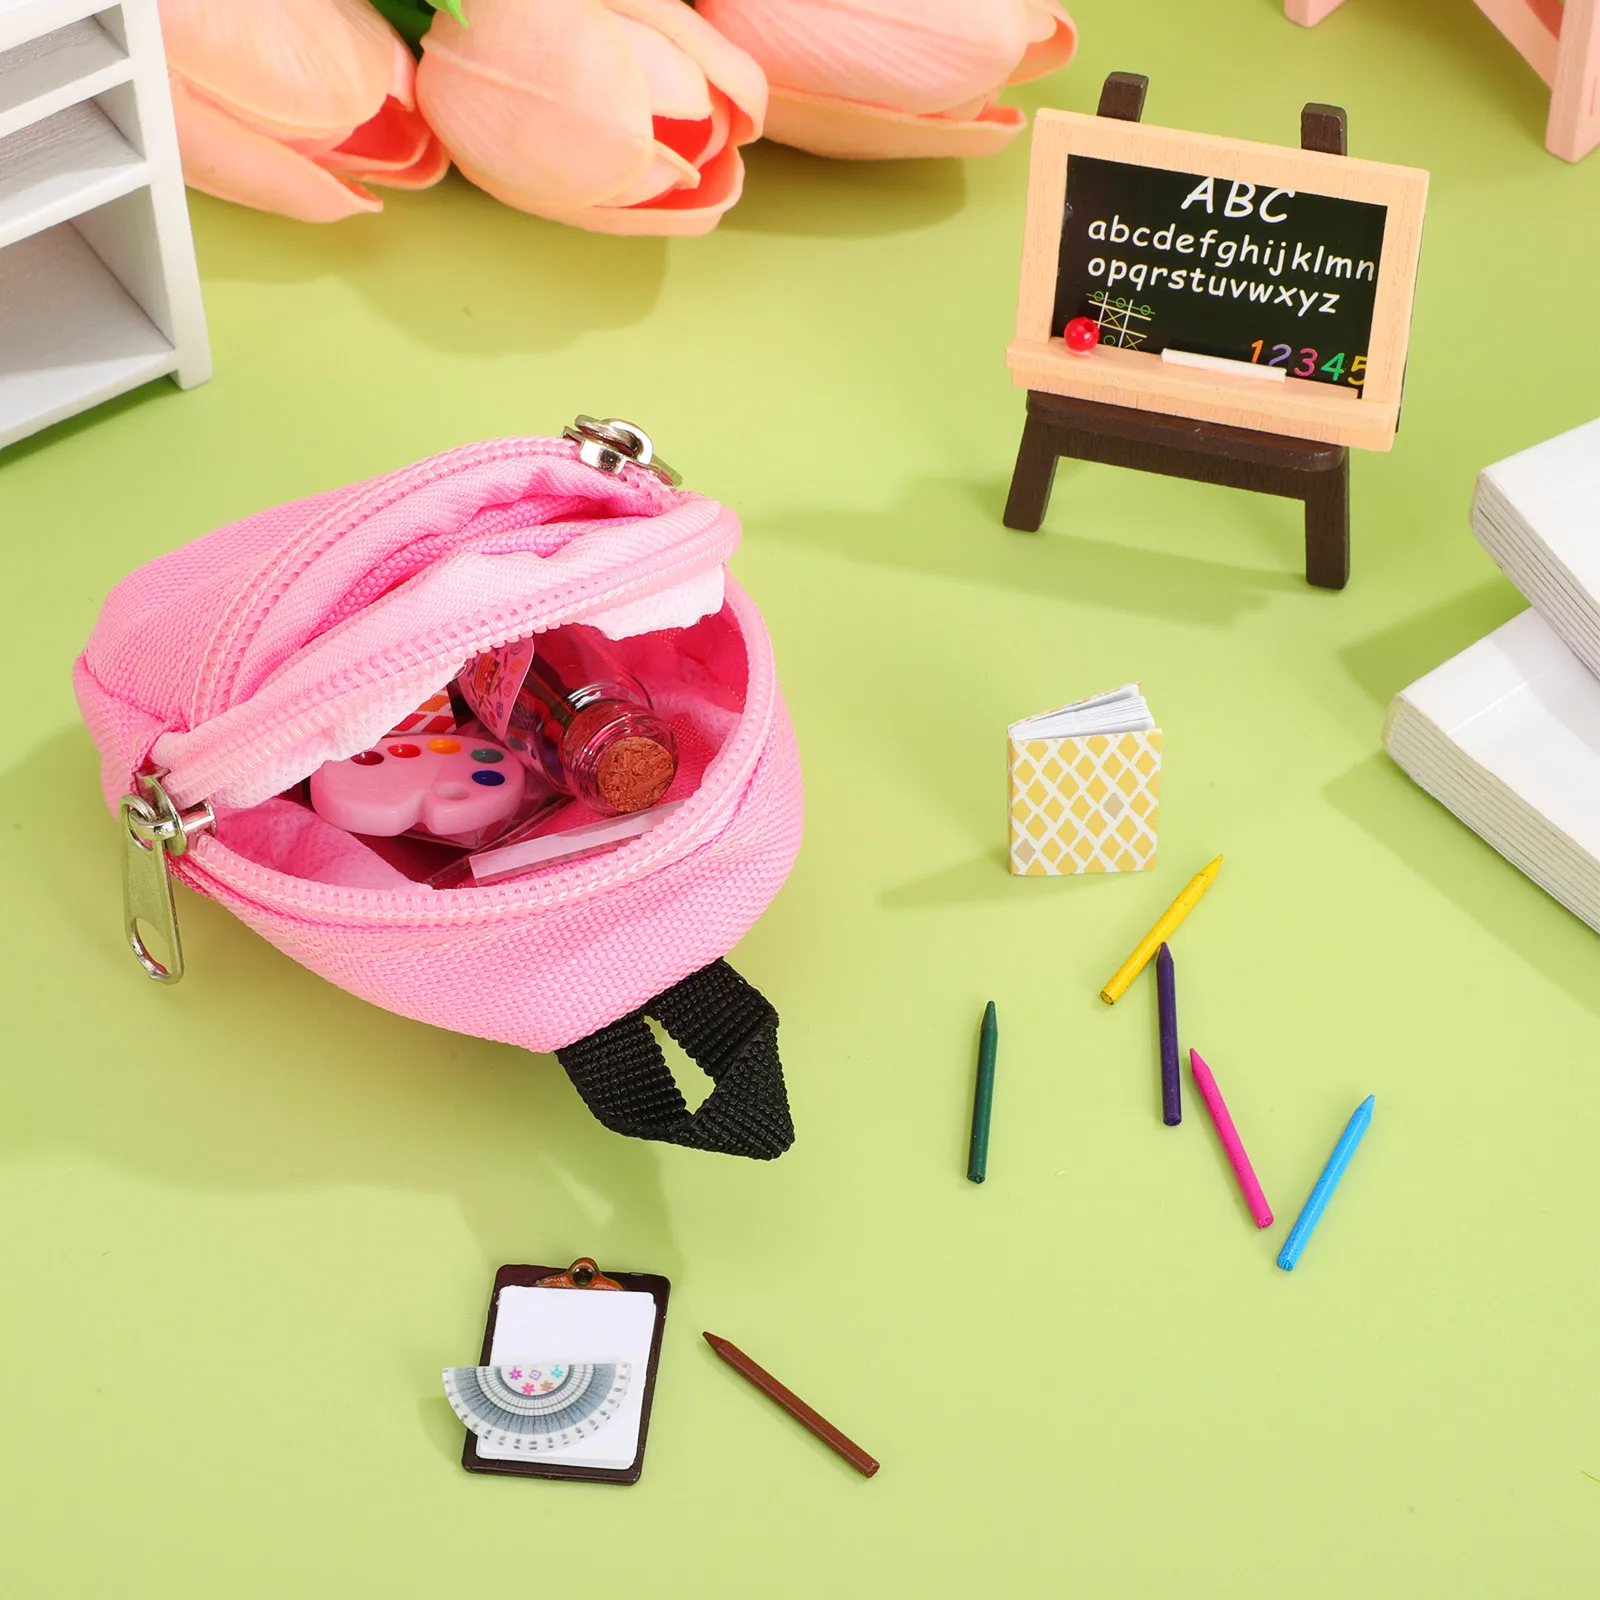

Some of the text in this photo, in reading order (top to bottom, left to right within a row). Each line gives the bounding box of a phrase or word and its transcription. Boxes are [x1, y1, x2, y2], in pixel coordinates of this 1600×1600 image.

[1180, 176, 1296, 223] ABC
[1088, 214, 1375, 282] abcdefghijklmn
[1087, 256, 1340, 317] opqrstuvwxyz
